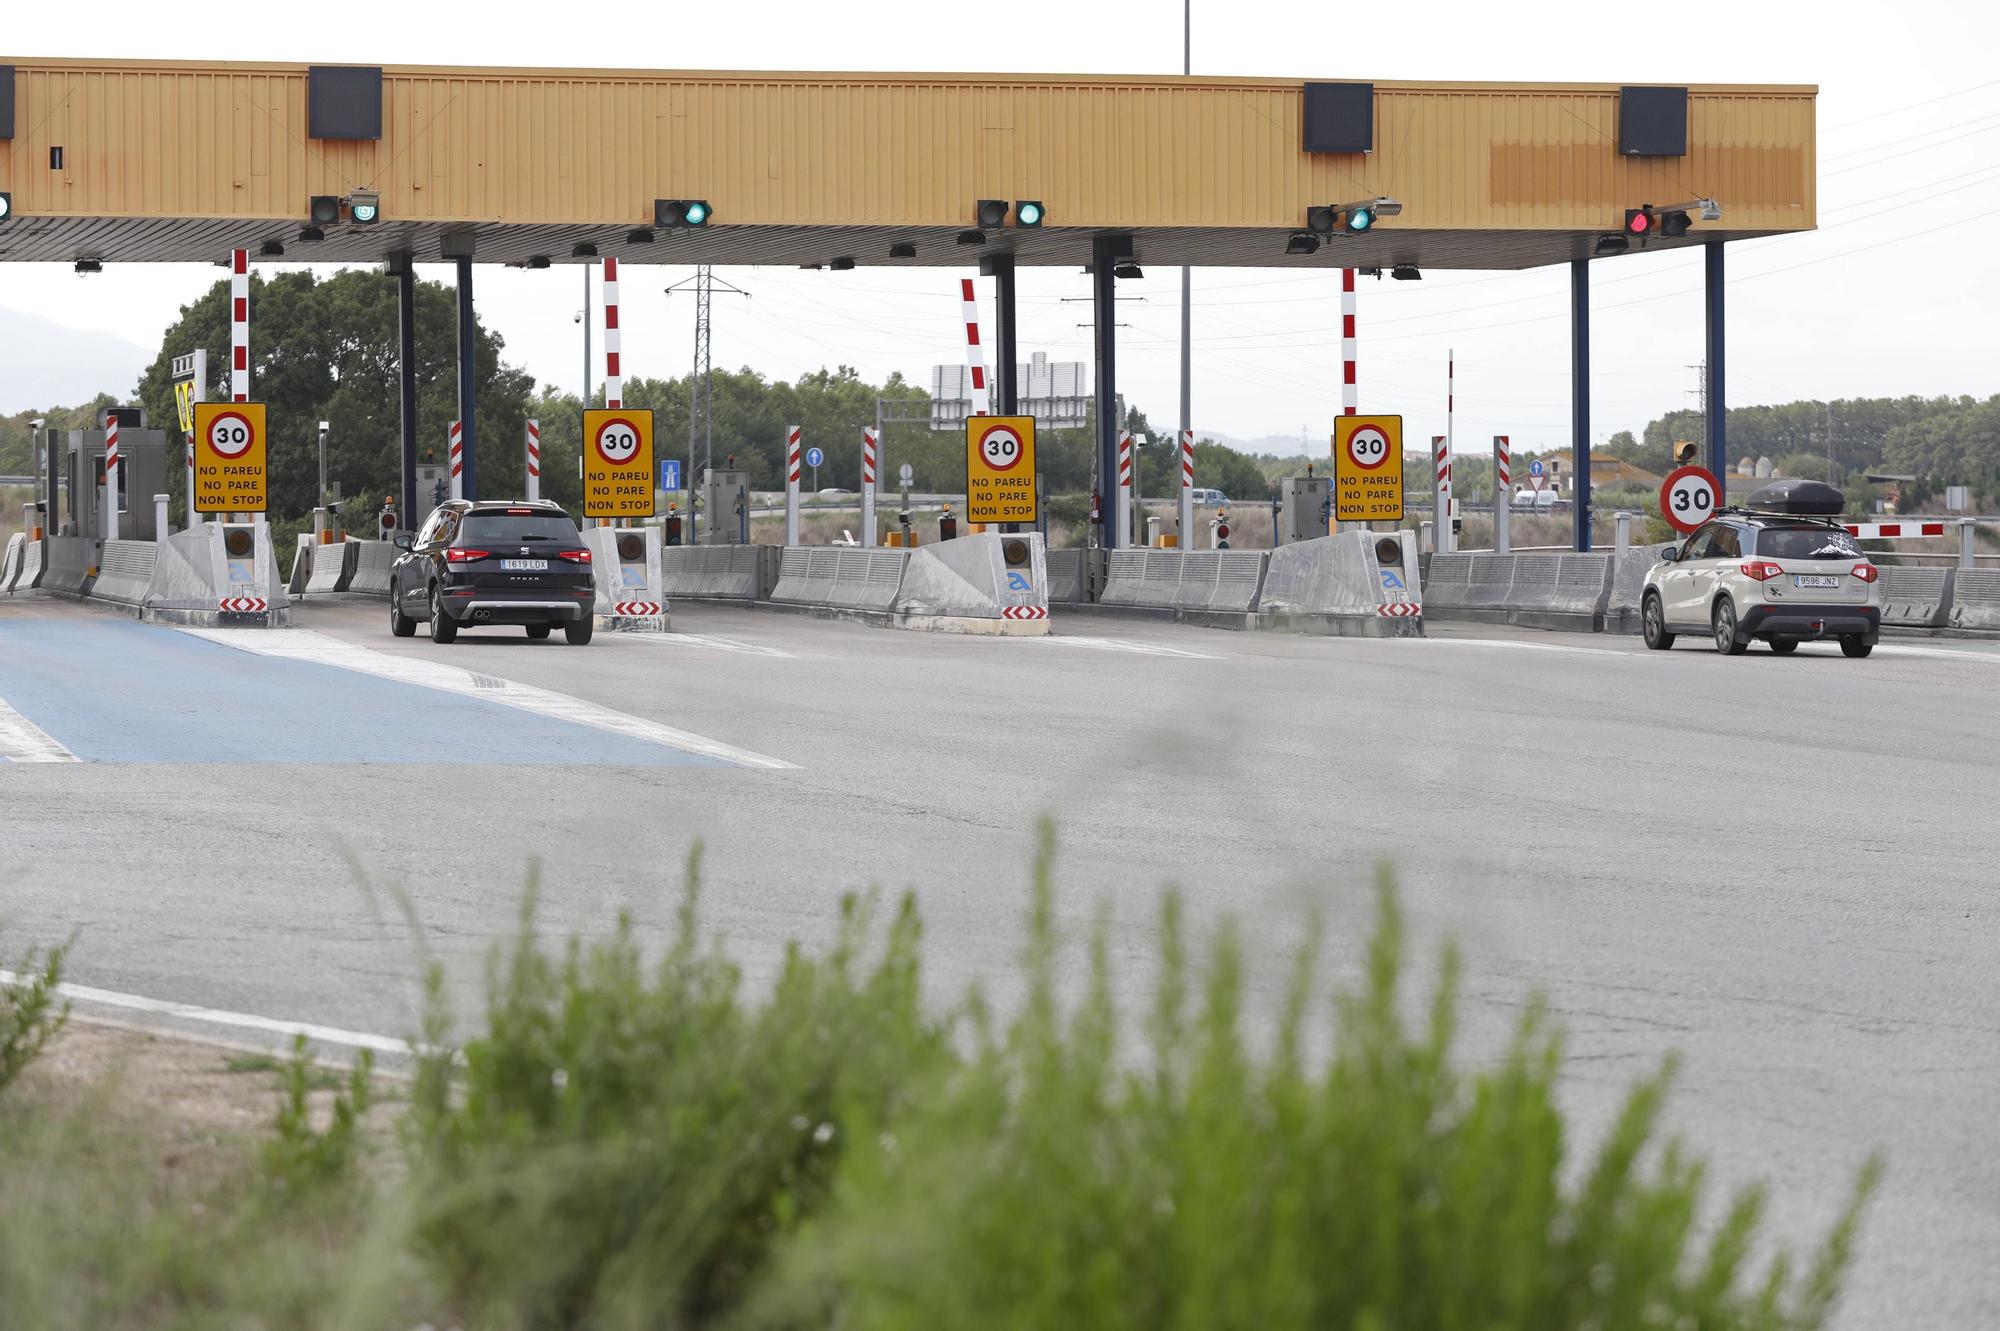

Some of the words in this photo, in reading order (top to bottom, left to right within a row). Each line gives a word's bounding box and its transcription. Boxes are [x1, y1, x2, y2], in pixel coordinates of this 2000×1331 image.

[216, 427, 246, 444] 30
[604, 433, 633, 451] 30
[1355, 438, 1383, 456] 30
[987, 440, 1016, 457] 30
[199, 466, 218, 476] NO
[223, 466, 262, 476] PAREU
[588, 471, 606, 482] NO
[611, 471, 650, 482] PAREU
[203, 480, 222, 491] NO
[227, 480, 259, 491] PARE
[971, 478, 989, 488] NO
[994, 477, 1032, 488] PAREU
[1340, 476, 1357, 486] NO
[1362, 476, 1398, 486] PAREU
[592, 486, 610, 496] NO
[615, 486, 646, 496] PARE
[976, 492, 994, 502] NO
[998, 491, 1028, 502] PARE
[1344, 490, 1362, 500] NO
[1366, 489, 1396, 500] PARE
[198, 495, 226, 505] NON
[231, 495, 264, 505] STOP
[1674, 488, 1711, 511] 30
[587, 500, 615, 511] NON
[619, 500, 651, 511] STOP
[971, 506, 997, 516] NON
[1002, 505, 1033, 516] STOP
[1339, 504, 1365, 514] NON
[1370, 503, 1400, 514] STOP
[507, 560, 528, 568] 1619
[529, 560, 546, 569] LDX
[1800, 576, 1820, 585] 9596
[1822, 576, 1837, 585] JNZ
